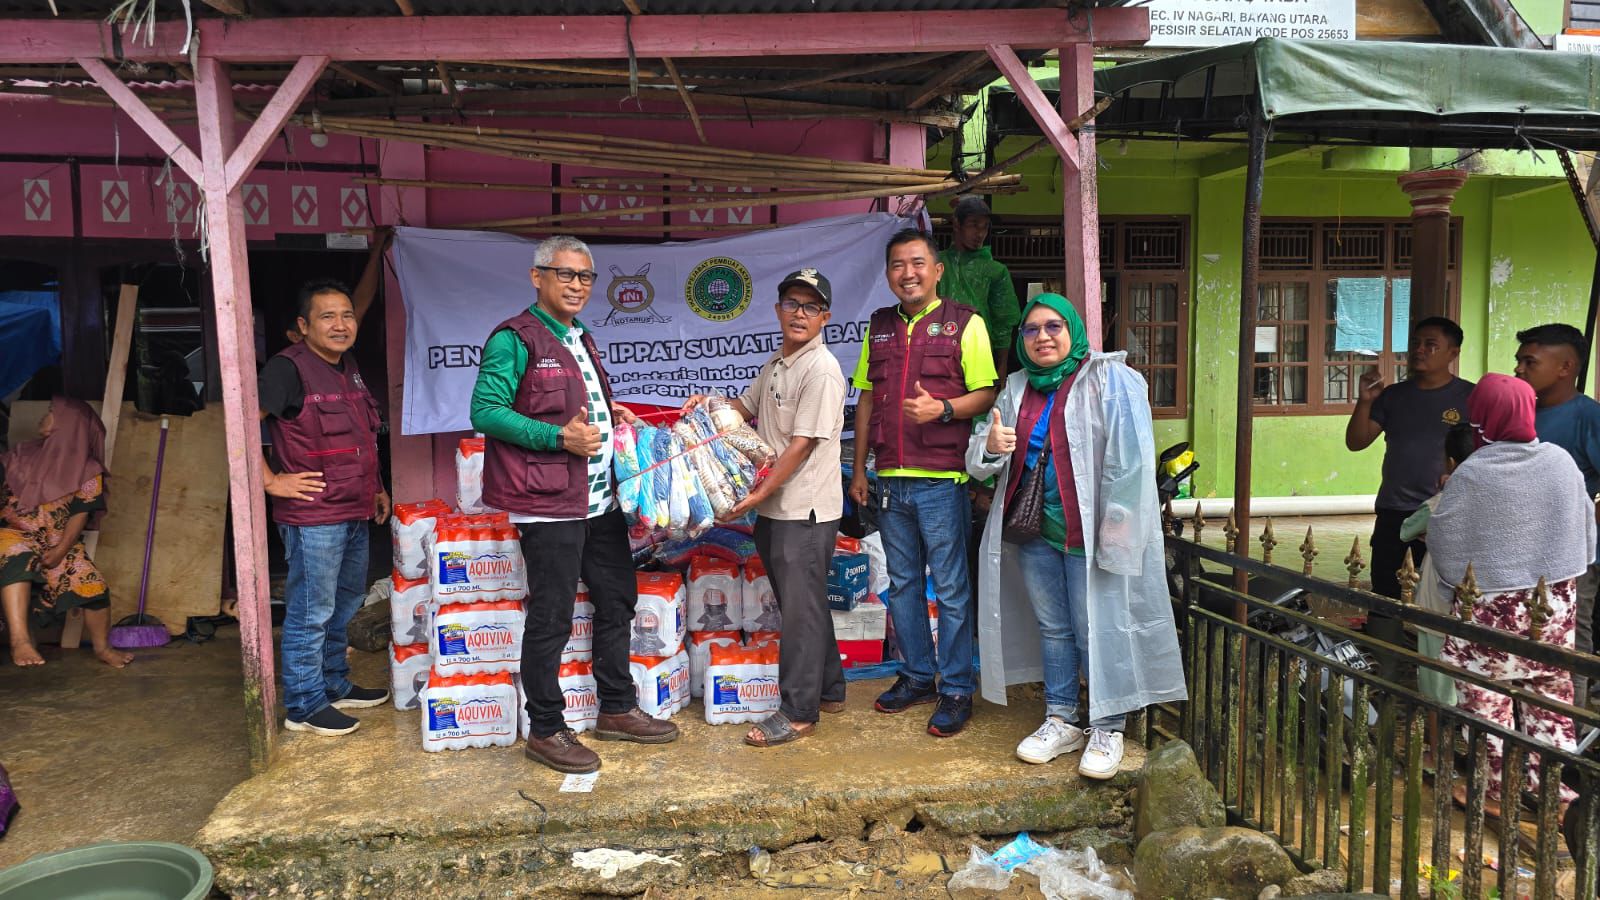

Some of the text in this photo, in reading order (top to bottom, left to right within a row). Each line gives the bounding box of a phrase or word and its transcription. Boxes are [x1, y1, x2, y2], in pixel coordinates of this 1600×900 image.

[1173, 10, 1185, 21] IV
[1187, 11, 1236, 23] NAGARI,
[1239, 13, 1287, 24] BAYANG
[1289, 14, 1328, 25] UTARA
[1150, 25, 1349, 40] PESISIR SELATAN KODE POS 25653
[610, 341, 681, 364] IPPAT
[622, 366, 699, 382] Notaris
[468, 560, 513, 577] AQUVIVA
[467, 631, 513, 648] AQUVIVA
[739, 683, 780, 699] AQUVIVA
[457, 704, 503, 721] AQUVIVA
